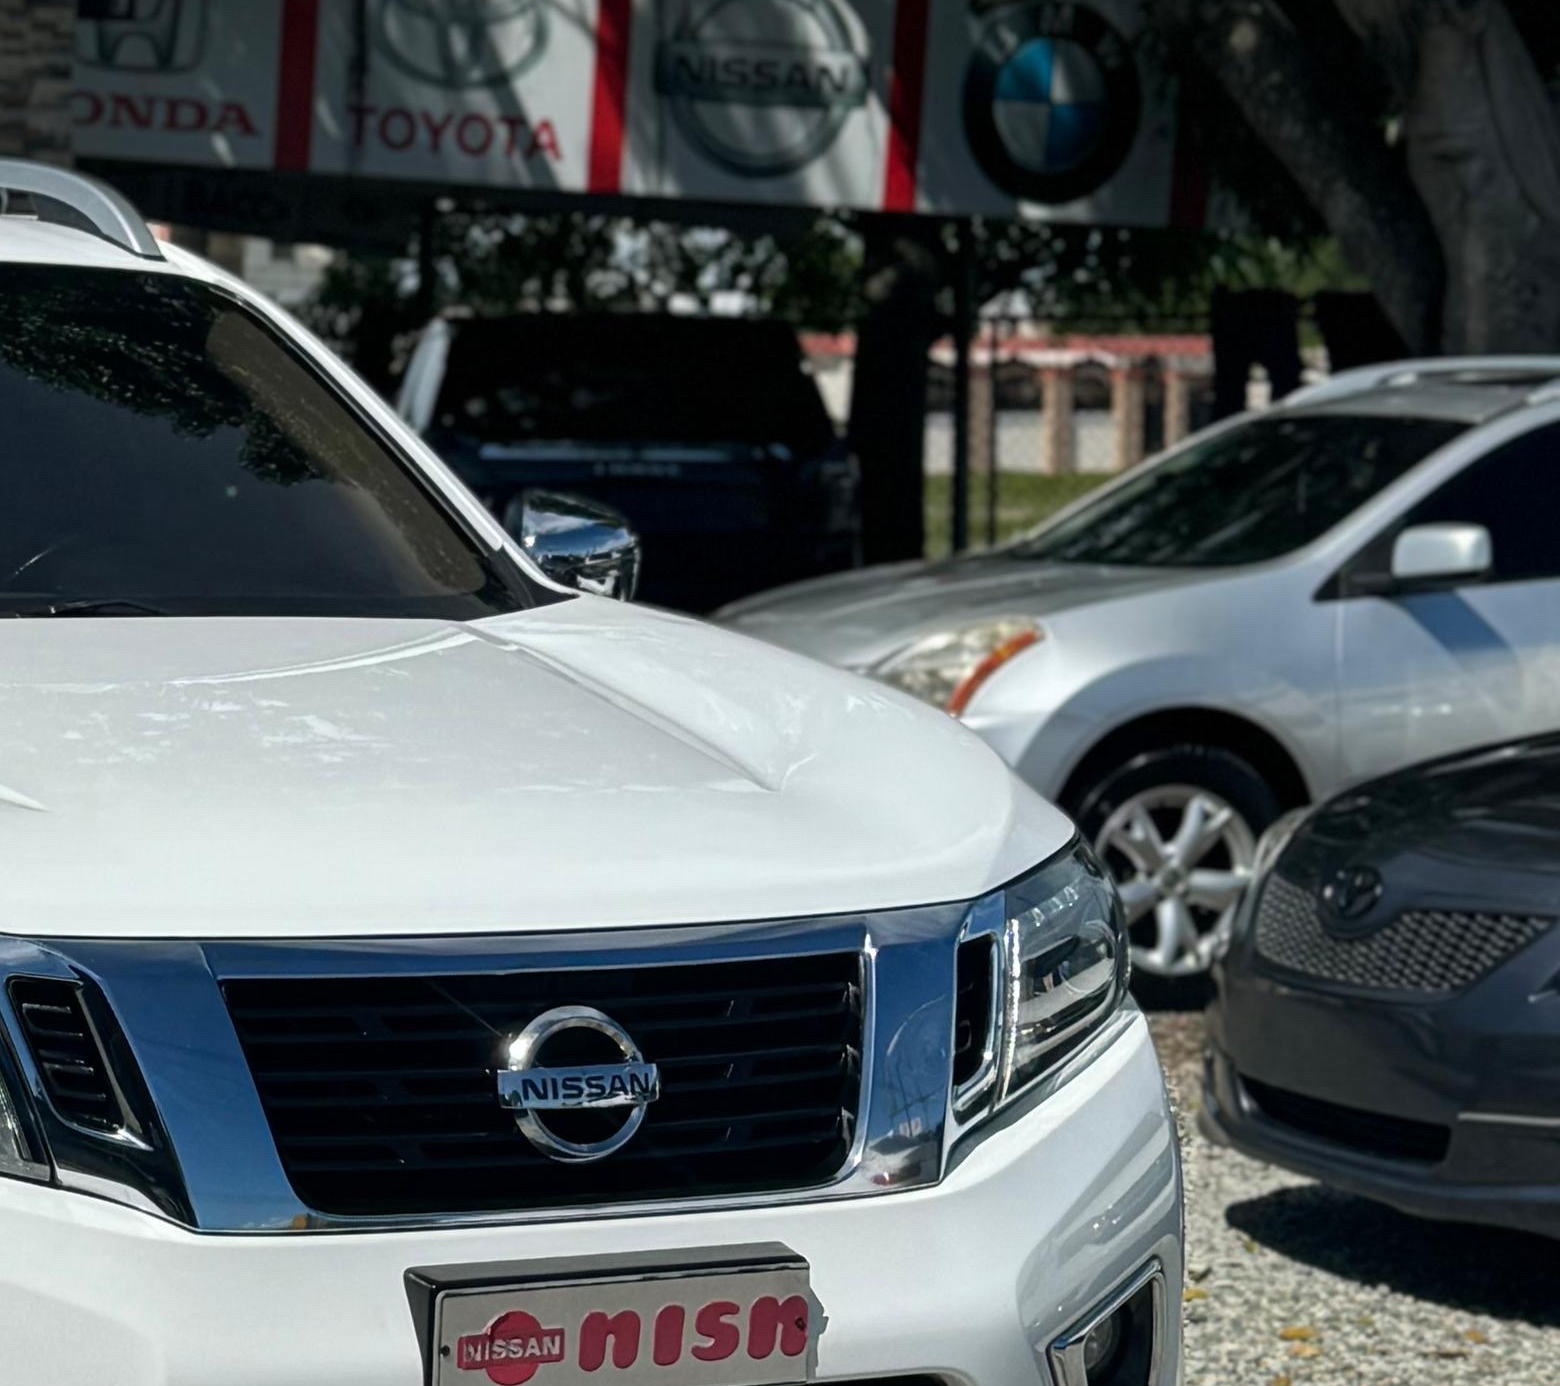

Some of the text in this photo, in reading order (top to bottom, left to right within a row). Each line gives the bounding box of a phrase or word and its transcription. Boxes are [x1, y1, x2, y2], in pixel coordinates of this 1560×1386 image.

[676, 53, 851, 93] NISSAN
[72, 91, 259, 136] ONDA
[354, 105, 563, 160] TOYOTA
[521, 1072, 650, 1101] NISSAN
[463, 1334, 560, 1364] NISSAN
